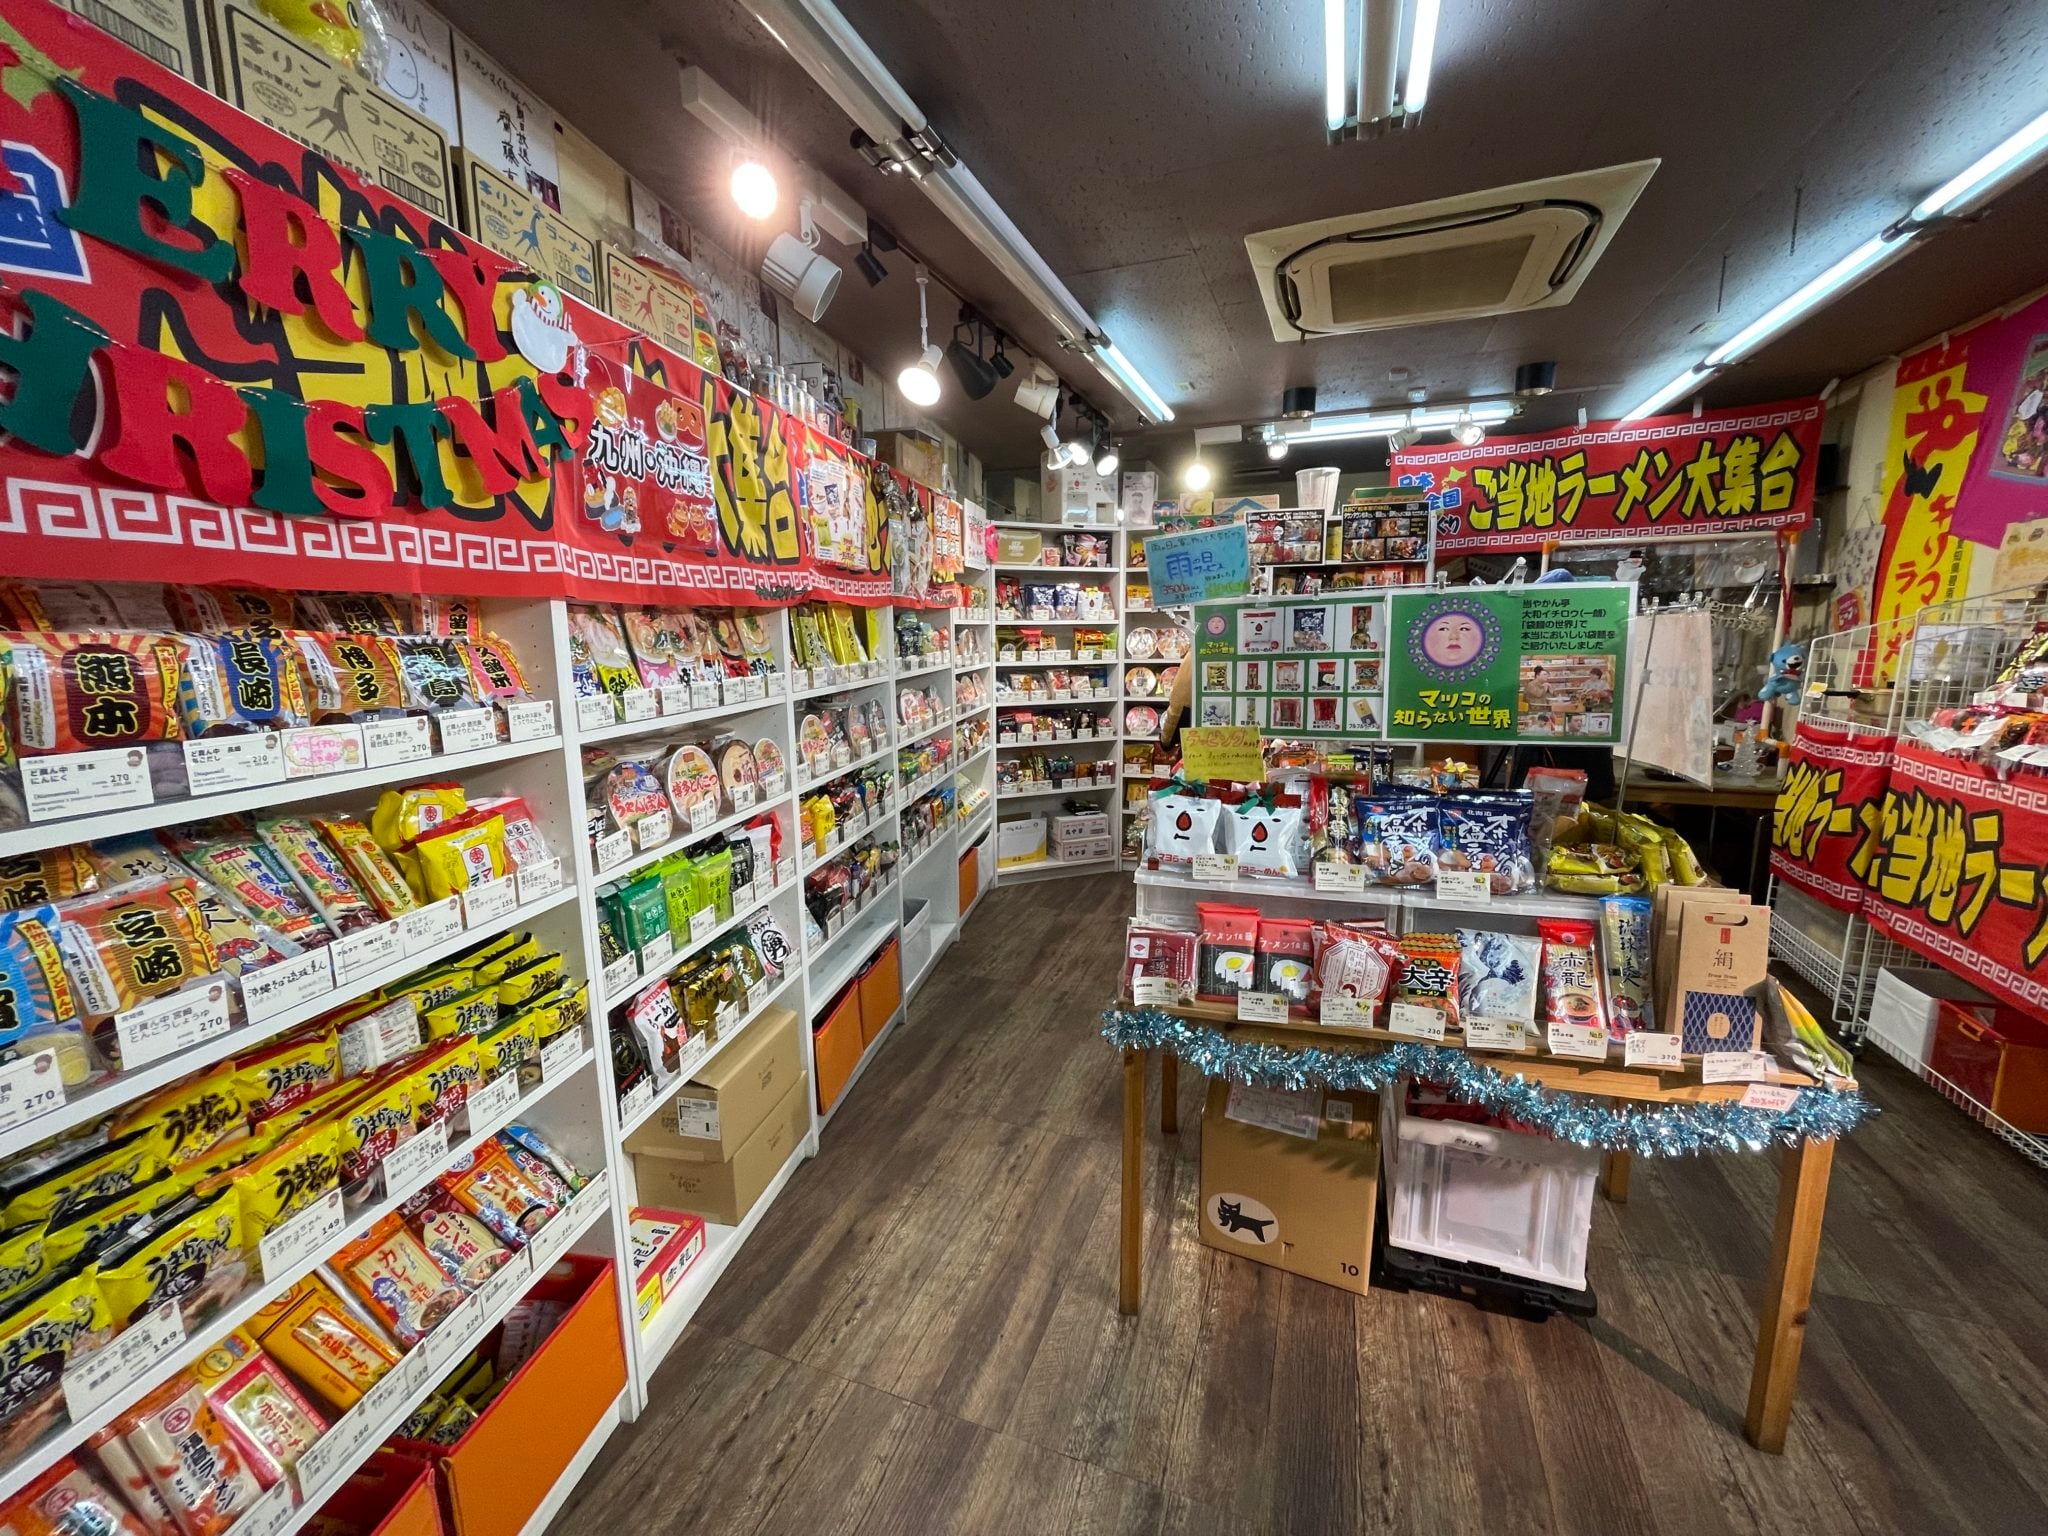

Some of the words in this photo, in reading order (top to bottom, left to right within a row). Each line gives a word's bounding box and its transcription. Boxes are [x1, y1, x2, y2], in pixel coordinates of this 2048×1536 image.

[241, 32, 322, 89] キリン
[360, 101, 439, 161] ラーメン
[478, 180, 523, 217] キリン
[55, 74, 509, 363] ERRY
[545, 222, 592, 263] ラーメン
[611, 266, 642, 292] キリン
[657, 292, 690, 321] ラーメン
[1397, 472, 1435, 490] 日本
[1467, 430, 1801, 531] ご当地ラーメン大集合
[1520, 640, 1604, 651] ご紹介いたしました
[230, 641, 275, 711] 長崎
[336, 645, 381, 703] 博多
[475, 646, 513, 690] 久留米
[74, 653, 139, 737] 熊本
[1418, 689, 1492, 707] マツコの
[1392, 706, 1512, 730] 知らない世界
[412, 744, 427, 752] 270
[481, 732, 494, 740] 270
[30, 774, 69, 785] にんにく
[110, 773, 130, 783] 270
[671, 774, 719, 798] 博多とんこつ
[612, 792, 670, 818] ちゃんぽん
[1466, 809, 1492, 817] 北海道
[1458, 820, 1492, 871] 塩ラーメ
[1484, 813, 1517, 878] オホーツクの
[1474, 875, 1486, 884] No.2
[501, 898, 514, 908] 155
[444, 921, 459, 932] 200
[112, 909, 183, 986] 宮崎
[1617, 918, 1641, 988] 琉球美人
[1712, 948, 1734, 970] 絹
[1399, 965, 1455, 992] 大辛
[1559, 951, 1593, 989] 赤龍
[128, 1015, 170, 1034] ど真ん中
[199, 1017, 223, 1033] 270
[1427, 1027, 1441, 1035] 230
[1506, 1023, 1524, 1032] No.11
[1661, 1053, 1677, 1061] 370
[266, 1057, 338, 1096] うまかっちゃん
[429, 1057, 480, 1096] うまかっちゃん
[24, 1089, 56, 1110] 270
[504, 1092, 517, 1106] 149
[161, 1090, 242, 1158] うまかっちゃん
[354, 1107, 413, 1148] うまかっちゃん
[430, 1145, 444, 1158] 149
[322, 1218, 341, 1236] 149
[1340, 1261, 1359, 1276] 10
[152, 1331, 178, 1354] 149
